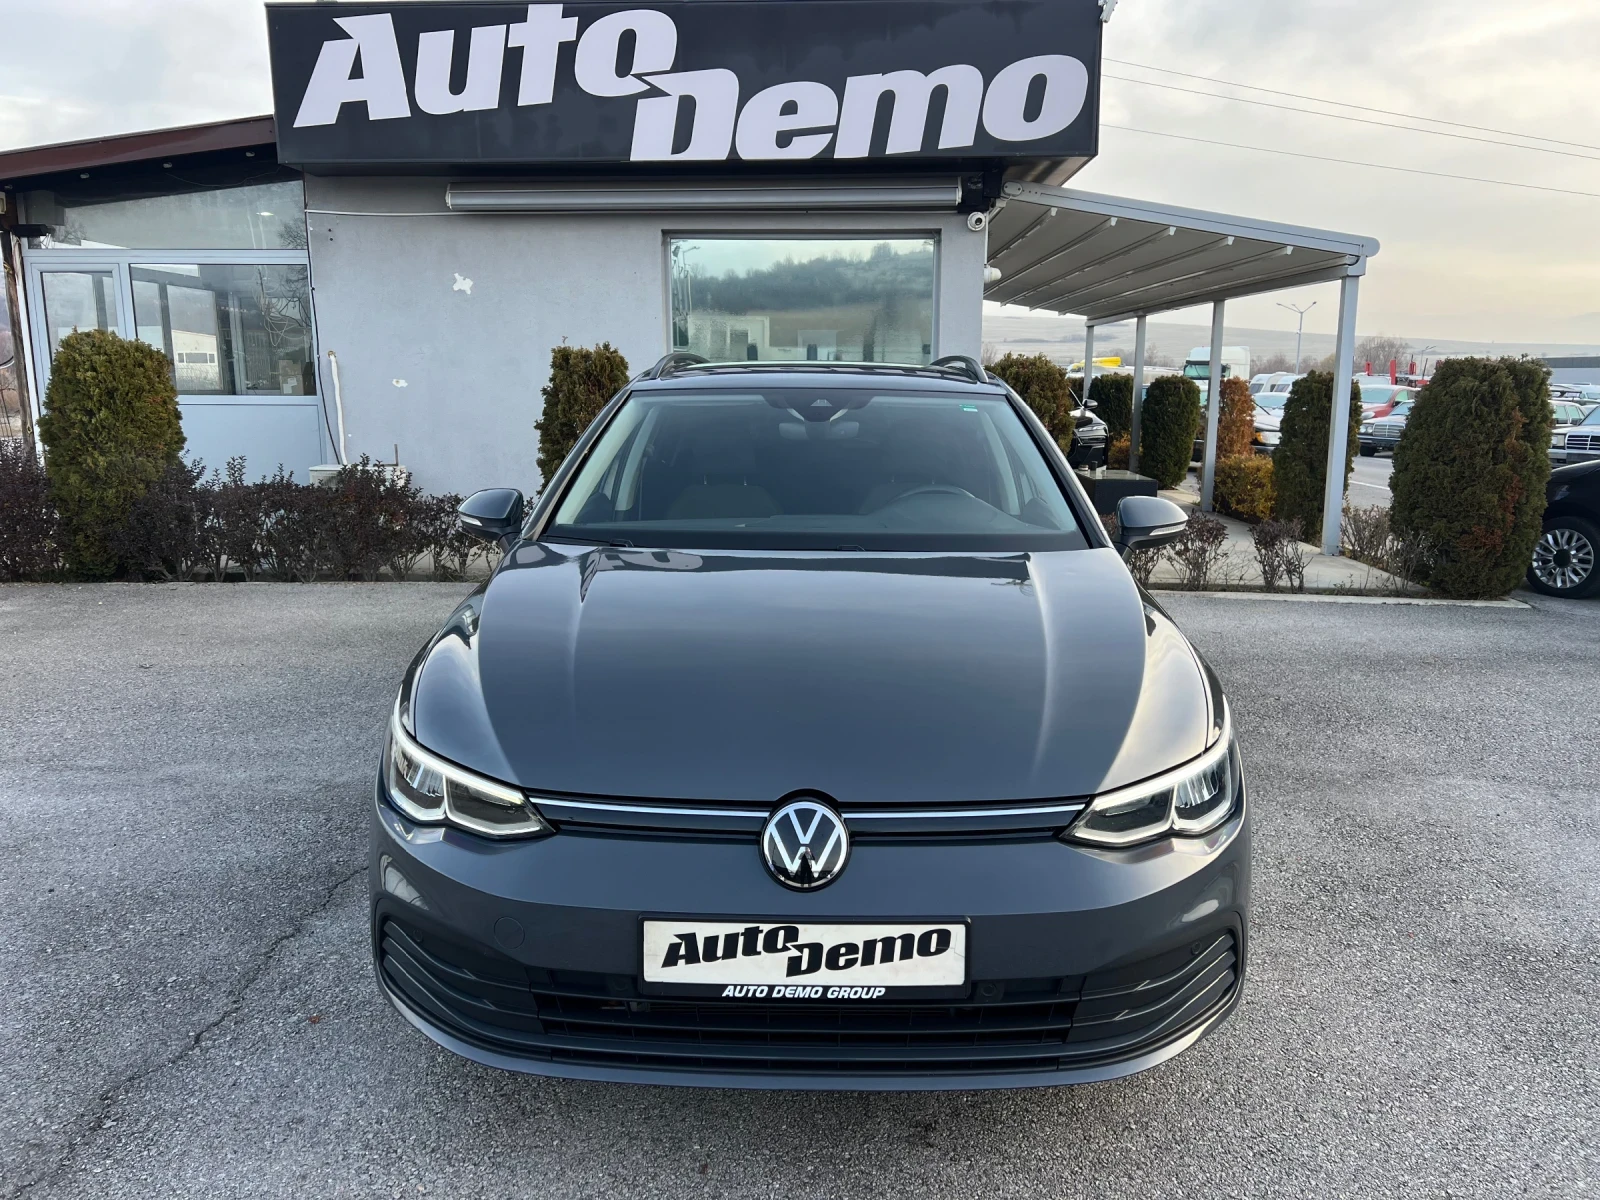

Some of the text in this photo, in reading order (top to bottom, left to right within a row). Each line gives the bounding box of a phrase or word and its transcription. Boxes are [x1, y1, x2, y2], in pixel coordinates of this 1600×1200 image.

[293, 4, 1089, 161] Auto Demo
[661, 925, 952, 978] Auto Demo
[721, 985, 886, 999] AUTO DEMO GROUP
